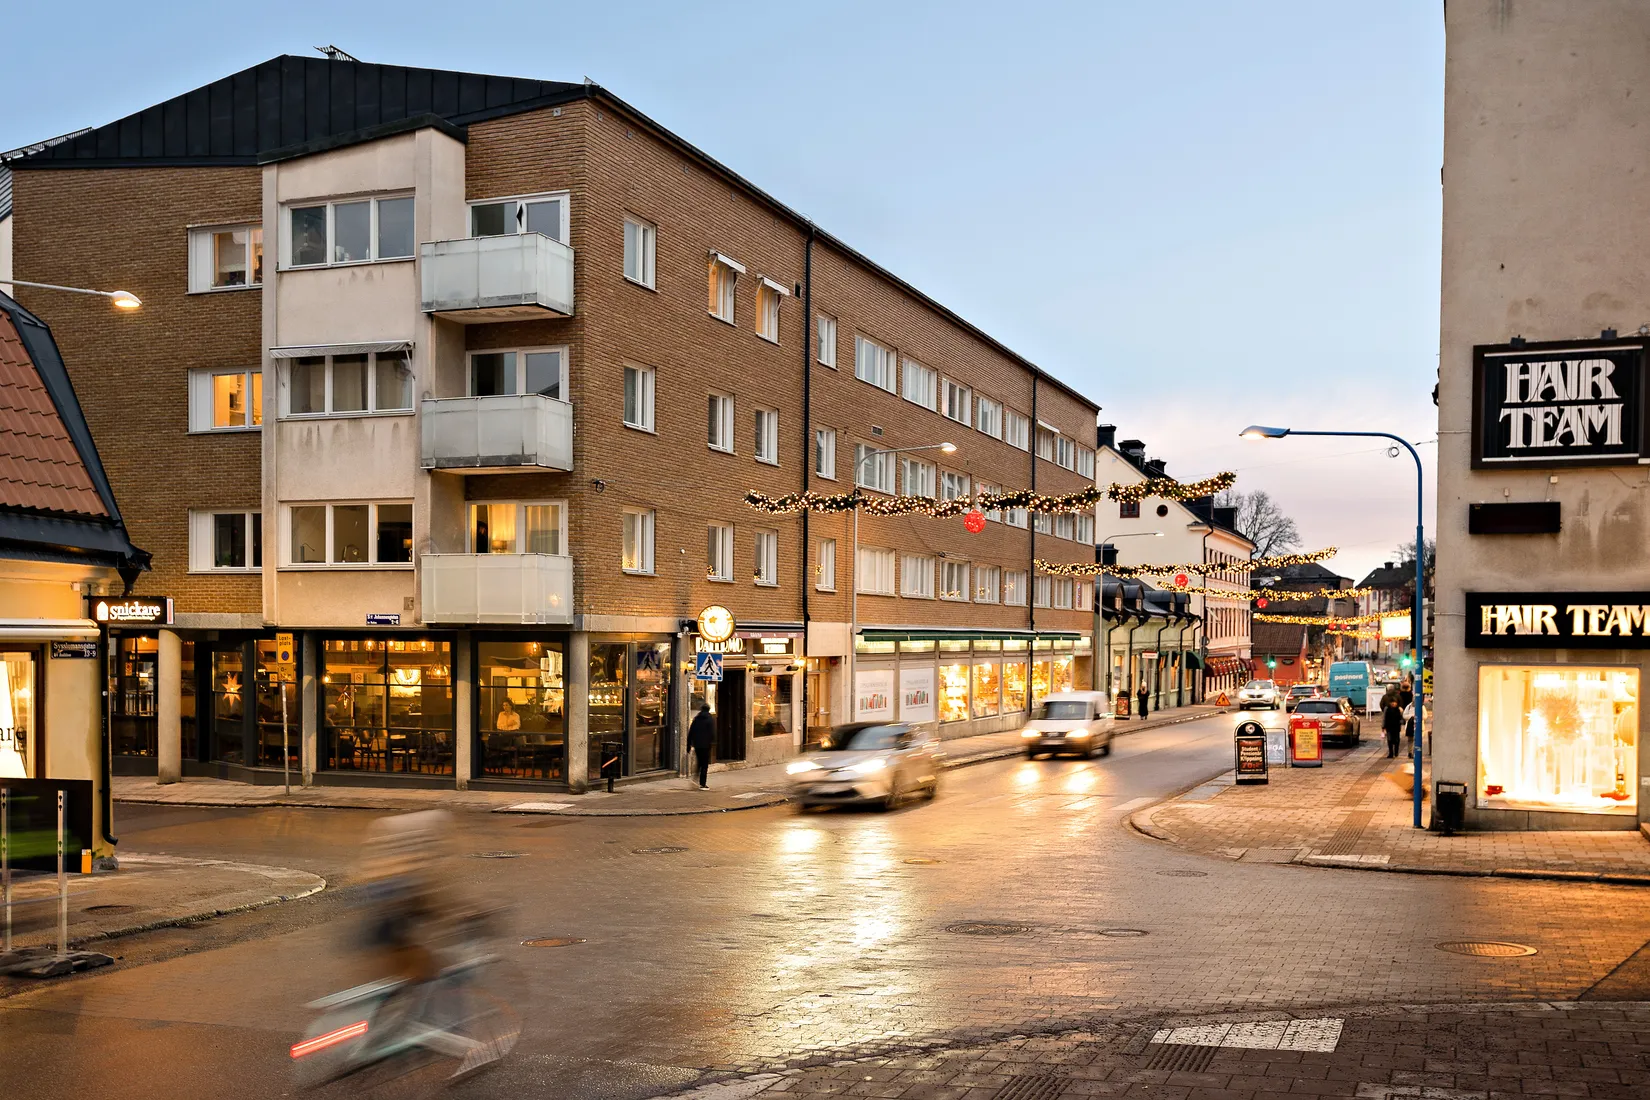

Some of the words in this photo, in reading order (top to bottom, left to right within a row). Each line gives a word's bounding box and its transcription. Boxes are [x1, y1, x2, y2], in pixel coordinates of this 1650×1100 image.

[1503, 358, 1622, 404] HAIR
[1498, 403, 1625, 449] TEAM
[109, 601, 161, 620] snickare
[1480, 604, 1560, 636] HAIR
[1565, 604, 1650, 637] TEAM
[695, 637, 744, 653] PALERMO
[1334, 673, 1364, 681] postnord
